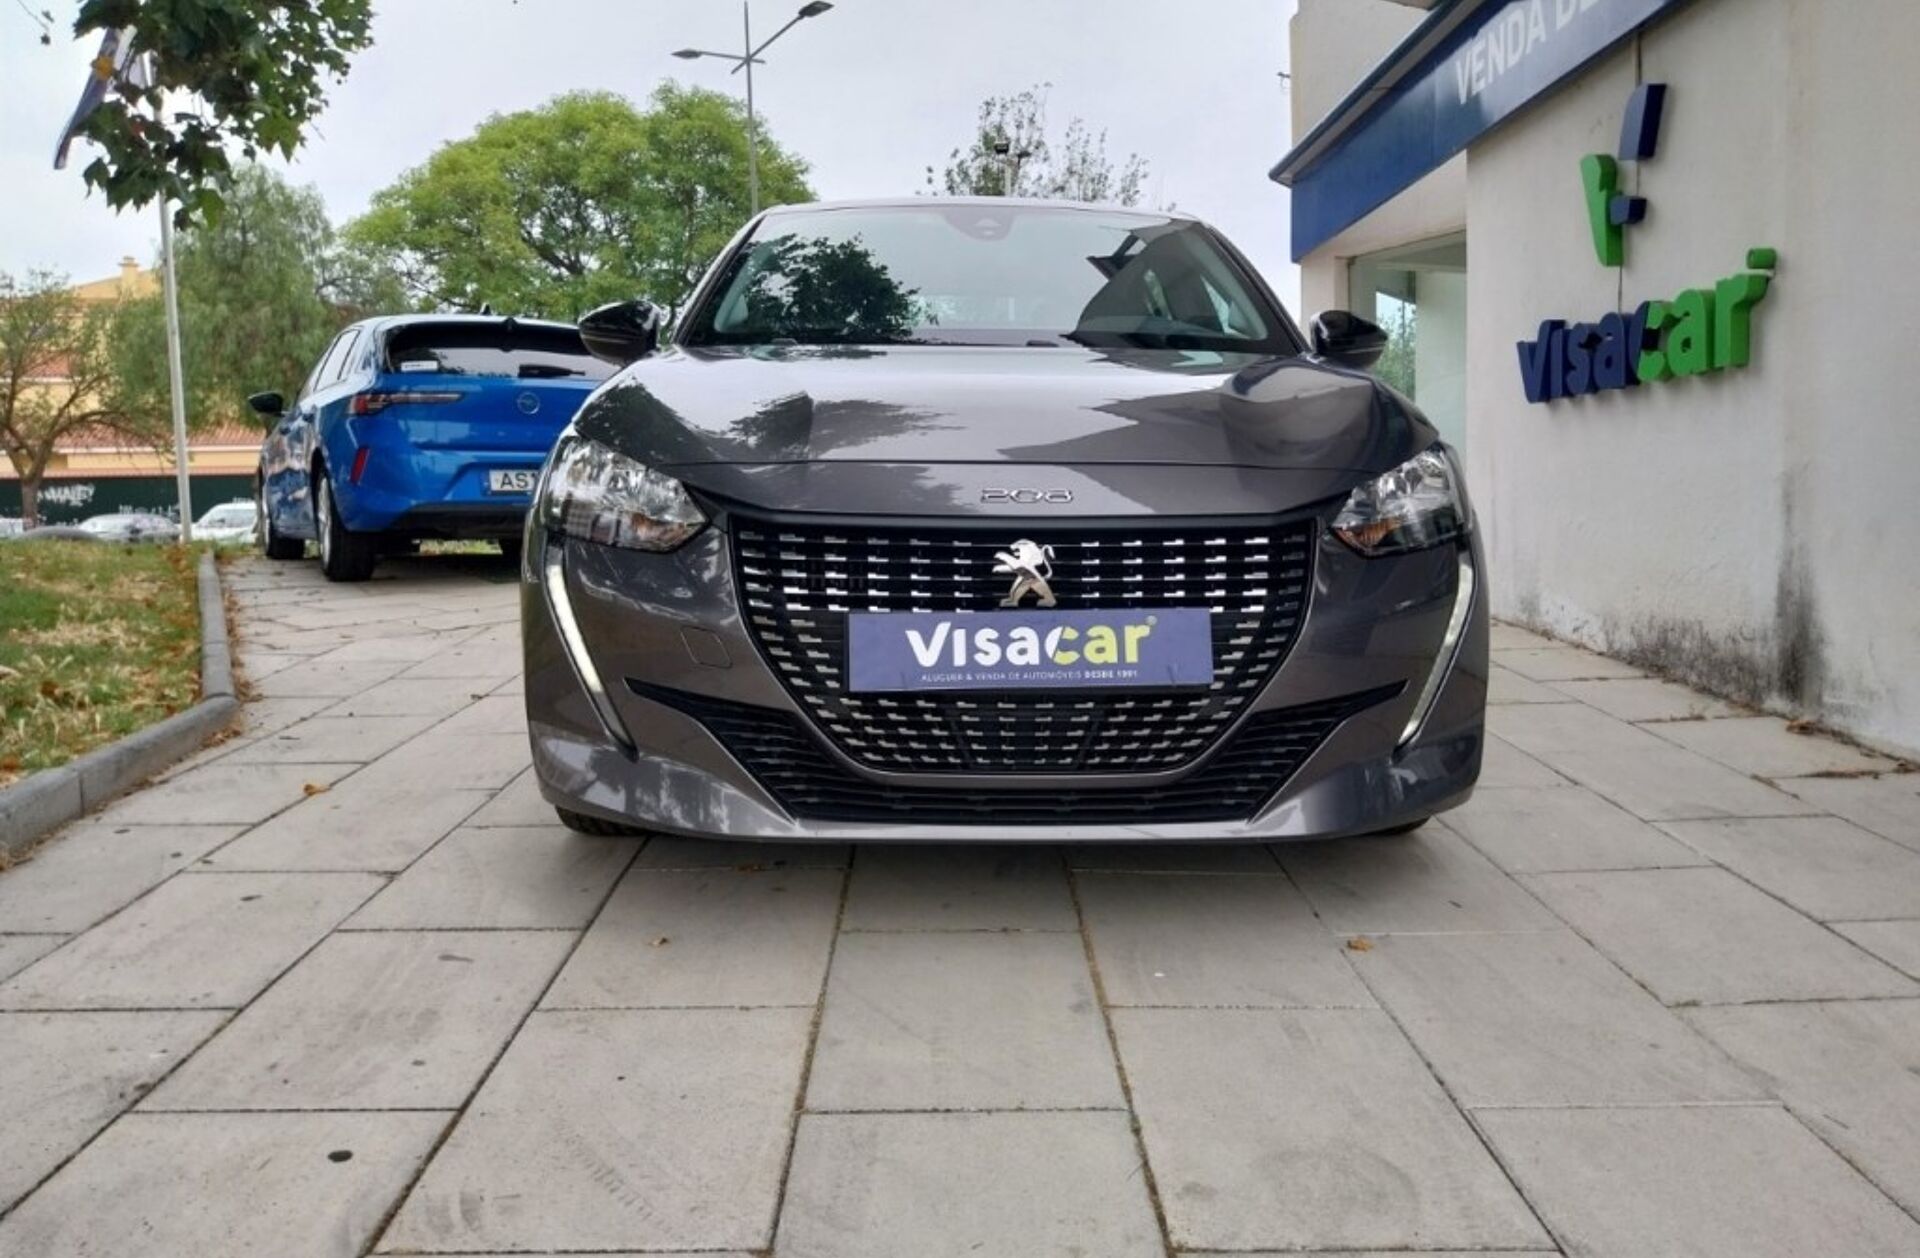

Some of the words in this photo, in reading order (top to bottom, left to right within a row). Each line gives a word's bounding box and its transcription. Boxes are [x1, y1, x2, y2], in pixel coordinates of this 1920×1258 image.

[1456, 0, 1546, 105] VENDA
[1556, 0, 1602, 31] D
[500, 471, 539, 489] AS
[980, 488, 1074, 504] 208
[1084, 670, 1113, 679] DESDE
